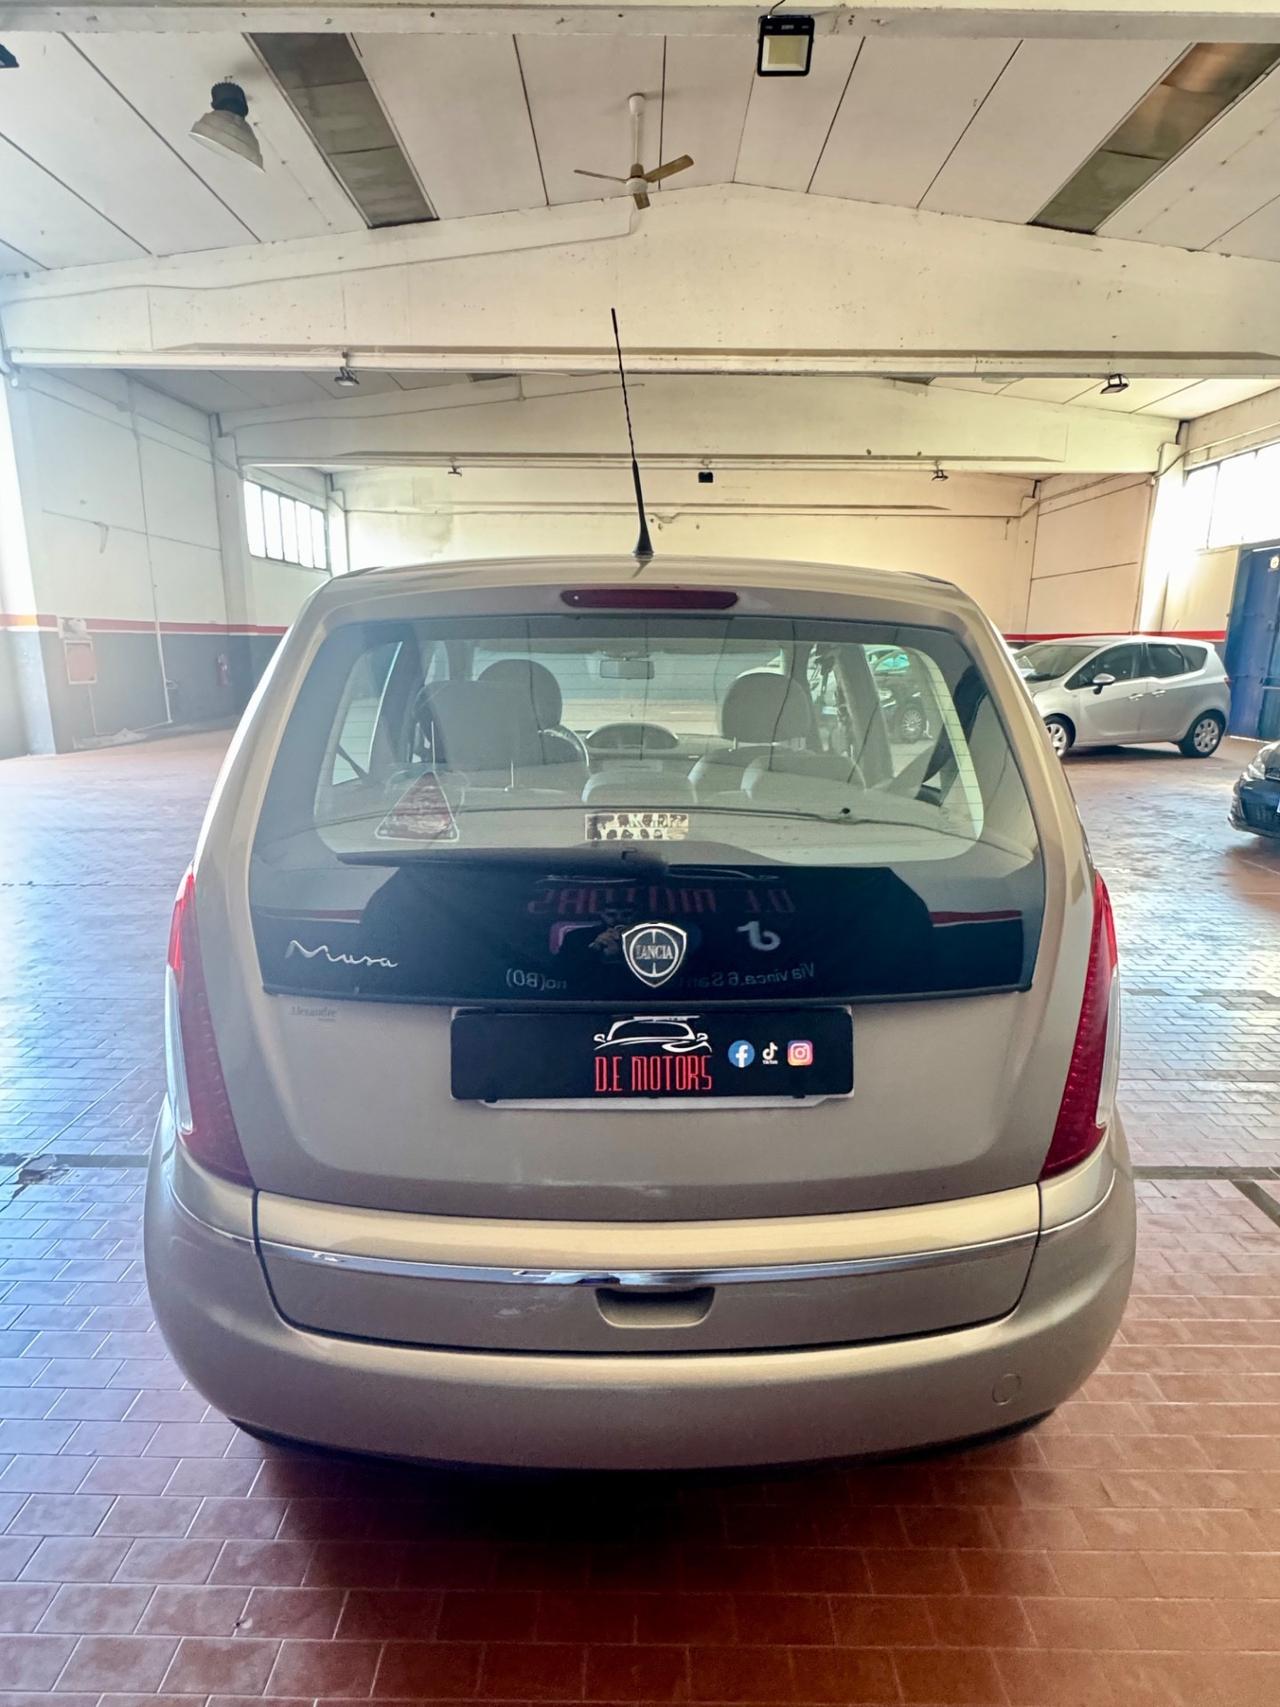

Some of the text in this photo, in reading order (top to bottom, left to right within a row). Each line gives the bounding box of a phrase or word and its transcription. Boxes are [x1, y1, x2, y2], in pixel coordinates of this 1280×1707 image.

[285, 939, 399, 969] Musa
[635, 944, 674, 960] LANCIA
[594, 1055, 713, 1092] D.E MOTORS
